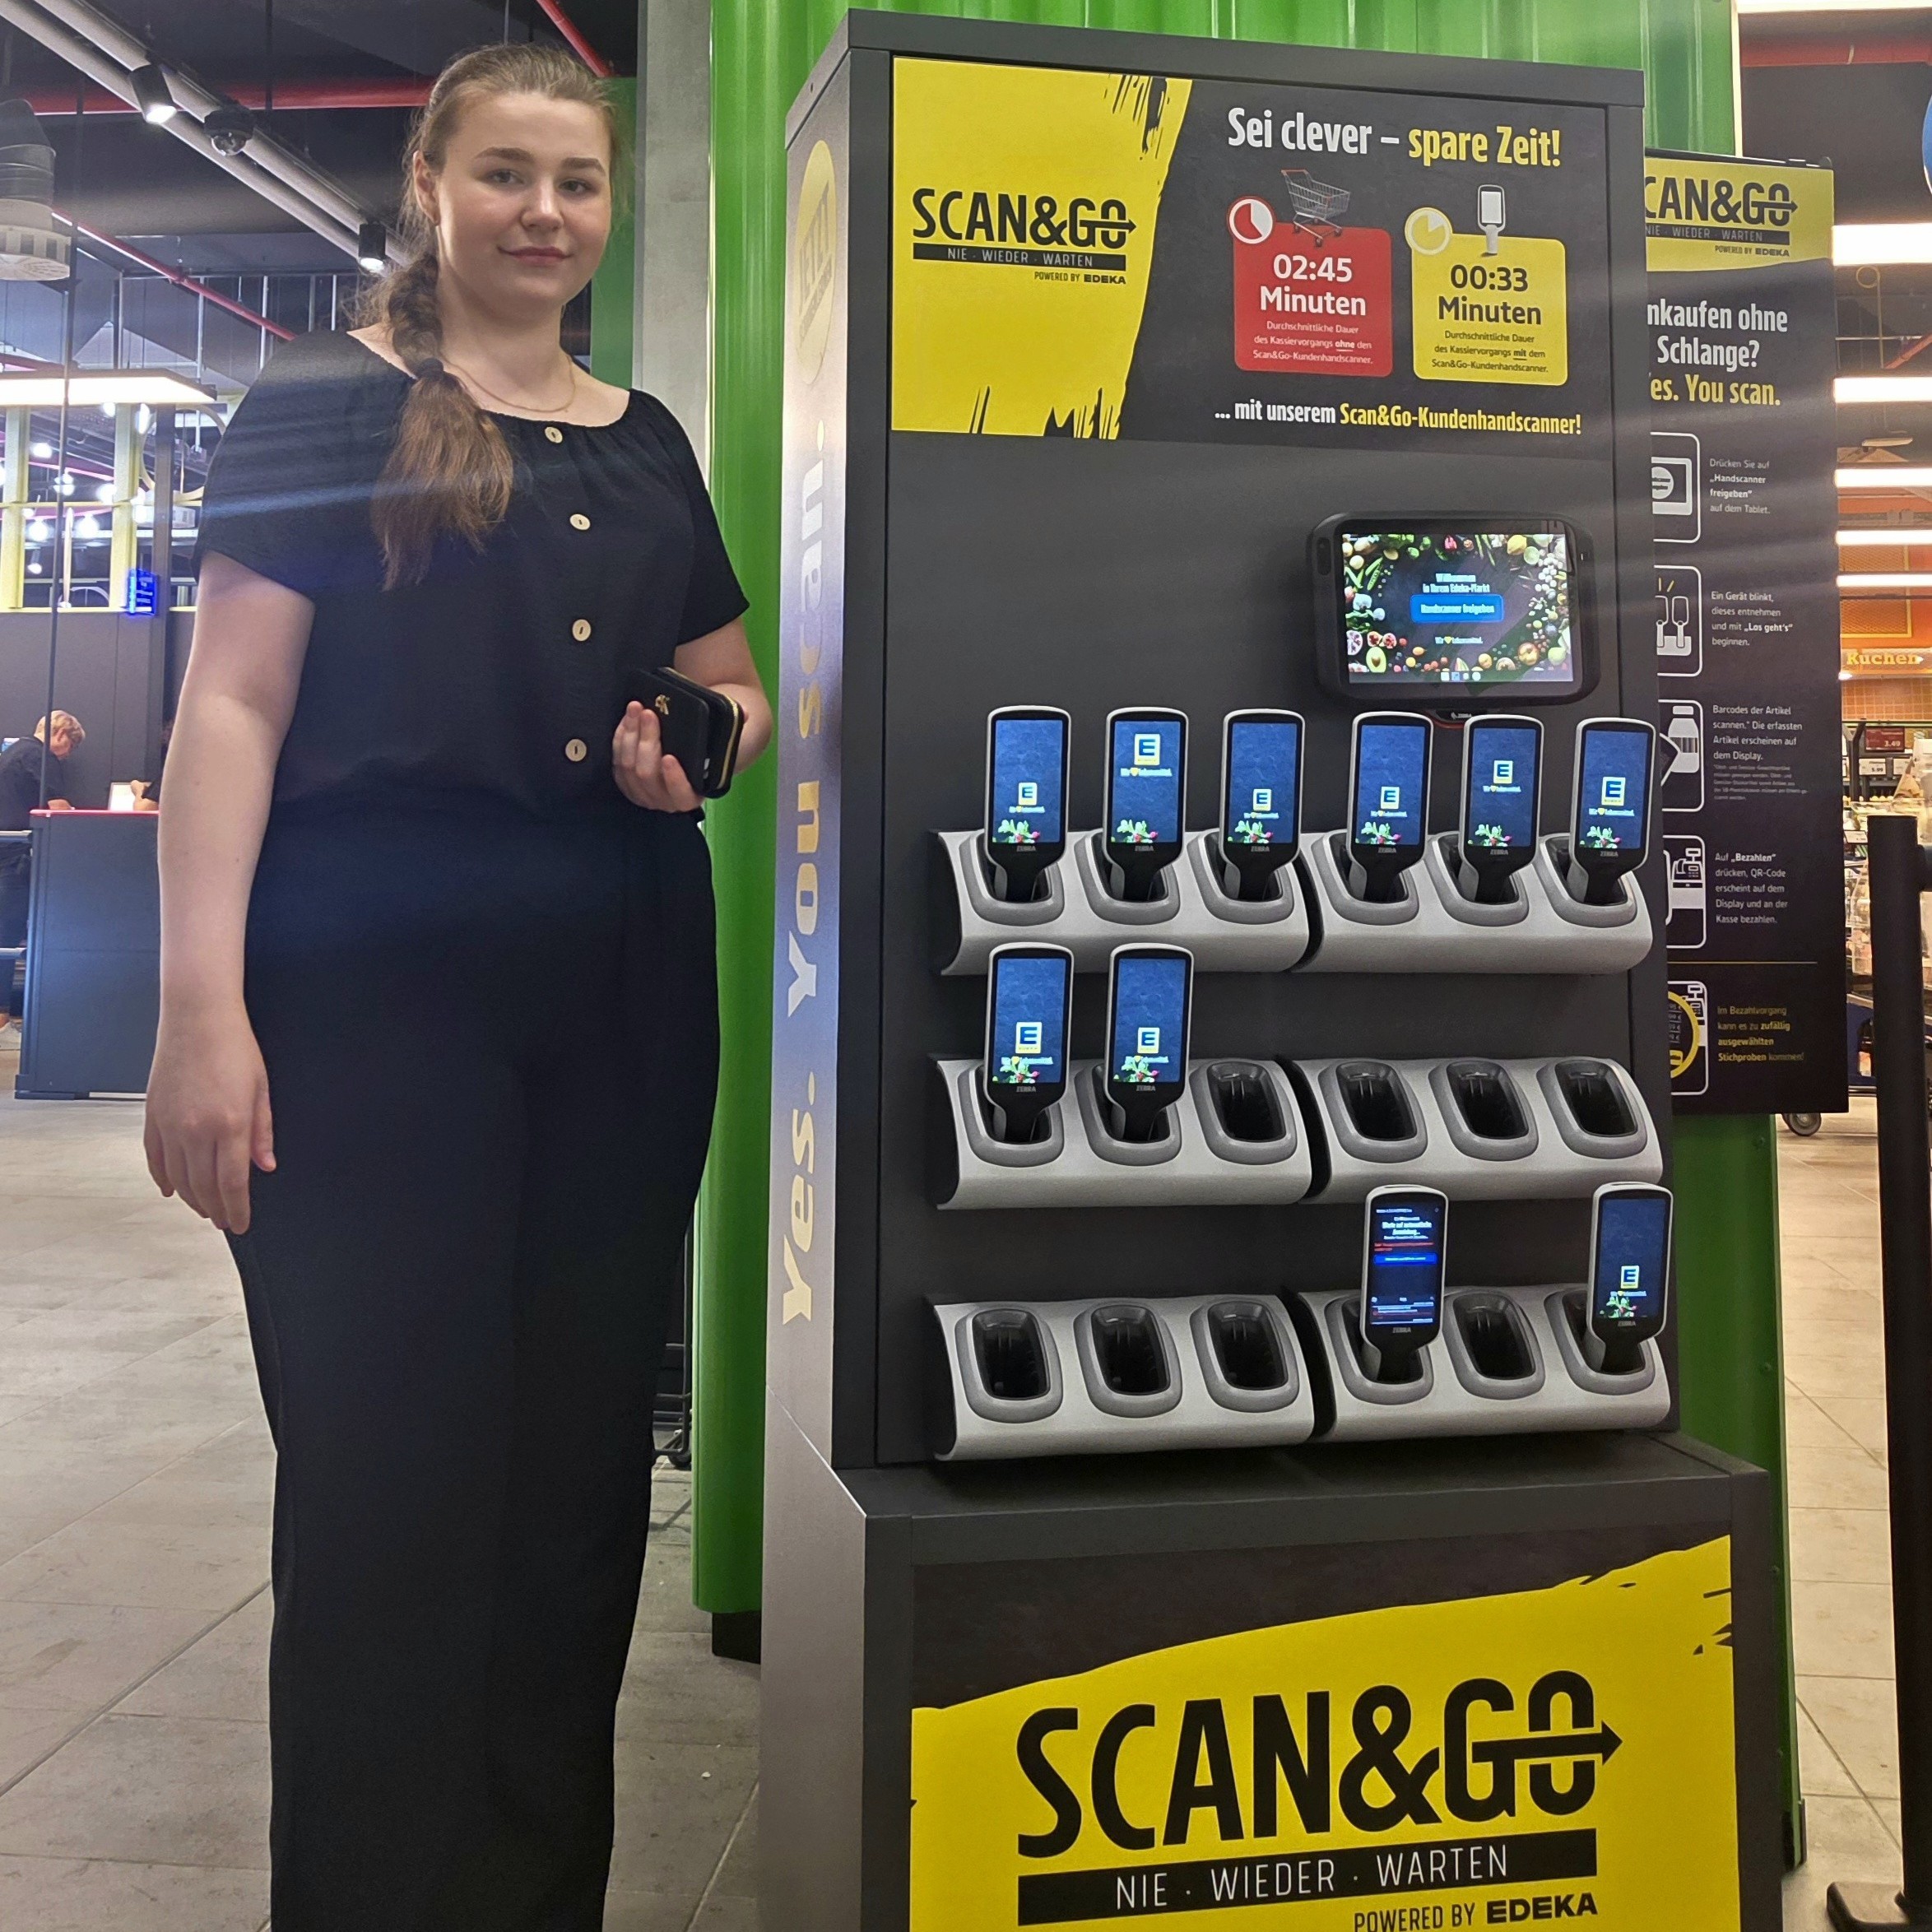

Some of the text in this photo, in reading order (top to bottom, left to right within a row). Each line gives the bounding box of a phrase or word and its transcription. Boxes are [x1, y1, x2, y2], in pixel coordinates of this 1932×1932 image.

[1228, 107, 1272, 148] Sei
[1281, 113, 1372, 154] clever
[1409, 128, 1488, 167] spare
[1496, 126, 1560, 167] Zeit!
[913, 188, 1126, 249] SCAN&GO
[1672, 225, 1711, 239] WIEDER
[1721, 229, 1762, 242] WARTEN
[948, 248, 1093, 267] NIE WIEDER WARTEN
[1755, 248, 1790, 257] EDEKA
[1274, 254, 1353, 282] 02:45
[1034, 272, 1126, 284] POWERED BY EDEKA
[1451, 264, 1529, 291] 00:33
[1261, 286, 1366, 316] Minuten
[1438, 296, 1541, 325] Minuten
[1647, 298, 1788, 332] nkaufen ohne
[1267, 321, 1359, 334] Durchschnittliche Dauer
[1254, 336, 1372, 349] des Kassiervorgangs ohne den
[1445, 330, 1535, 343] Durchschnittliche Dauer
[1252, 350, 1374, 365] Scan&Go-Kundenhandscanner.
[1434, 345, 1545, 358] des Kassiervorgangs mit dem
[1657, 335, 1760, 373] Schlange?
[1432, 359, 1549, 373] Scan&Go-Kundenhandscanner.
[1685, 374, 1724, 403] You
[1730, 382, 1781, 406] scan.
[1234, 399, 1262, 420] mit
[1266, 402, 1336, 424] unserem
[1340, 402, 1581, 435] Scan&Go-Kundenhandscanner!
[1710, 457, 1769, 469] Drücken Sie auf
[1710, 504, 1770, 514] auf dem Tablet.
[1711, 591, 1774, 603] Ein Gerät blinkt,
[1711, 606, 1781, 617] dieses entnehmen
[1711, 622, 1726, 630] und
[1729, 622, 1742, 630] mit
[1711, 637, 1750, 647] beginnen.
[1846, 651, 1920, 666] Kuchen
[1712, 704, 1791, 715] Barcodes der Artikel
[1752, 721, 1765, 730] Die
[1767, 722, 1803, 731] erfassten
[1712, 735, 1797, 745] Artikel erscheinen auf
[1713, 750, 1763, 761] dem Display.
[1715, 852, 1729, 862] Auf
[783, 419, 824, 1326] Yes. You scan.
[1715, 868, 1786, 878] drücken, QR-Code
[1715, 884, 1785, 893] erscheint auf dem
[1716, 899, 1744, 909] Display
[1746, 900, 1762, 908] und
[1776, 900, 1788, 908] der
[1716, 915, 1777, 924] Kasse bezahlen.
[1730, 1005, 1787, 1016] Bezahlvorgang
[1718, 1038, 1774, 1047] ausgewählten
[1718, 1052, 1767, 1062] Stichproben
[1015, 1670, 1596, 1858] SCAN&GO
[1116, 1844, 1507, 1911] NIE WIEDER WARTEN
[1354, 1892, 1599, 1932] POWERED BY EDEKA
